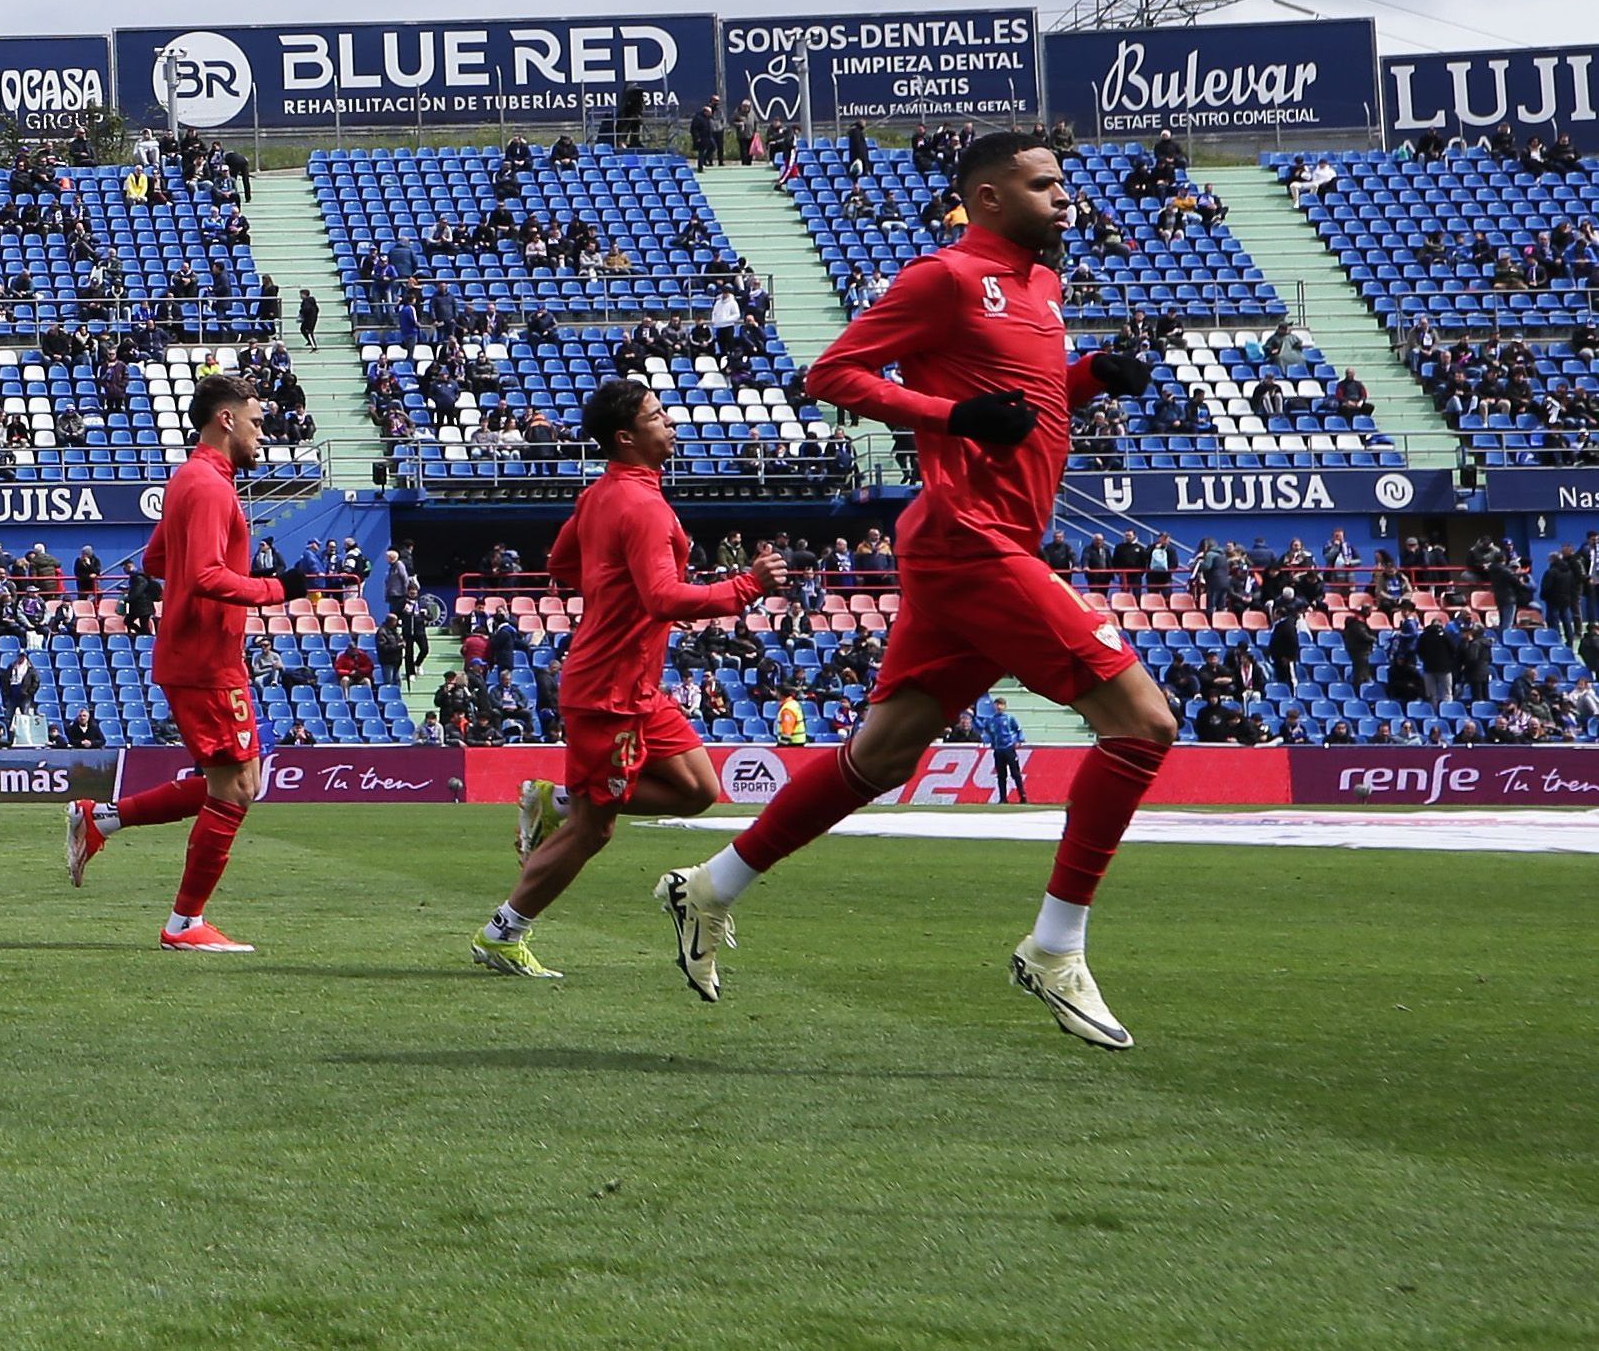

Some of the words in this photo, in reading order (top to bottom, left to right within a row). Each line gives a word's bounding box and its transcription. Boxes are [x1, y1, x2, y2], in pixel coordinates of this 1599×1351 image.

[279, 30, 490, 90] BLUE
[509, 25, 678, 85] RED
[833, 55, 933, 75] LIMPIEZA
[940, 52, 1024, 72] DENTAL
[176, 60, 240, 98] BR
[893, 77, 969, 97] GRATIS
[1102, 40, 1317, 112] Bulevar
[284, 92, 446, 115] REHABILITACIÓN
[453, 96, 477, 111] DE
[483, 91, 577, 110] TUBERÍAS
[586, 92, 616, 107] SIN
[643, 91, 679, 106] BRA
[1390, 55, 1597, 130] LUJI
[956, 101, 973, 112] EN
[1104, 113, 1161, 130] GETAFE
[1170, 111, 1229, 128] CENTRO
[1233, 107, 1319, 125] COMERCIAL
[982, 276, 1002, 298] 15
[1175, 474, 1334, 511] LUJISA
[230, 689, 248, 722] 5
[0, 761, 69, 792] más
[318, 764, 353, 790] Tu
[359, 767, 433, 790] tren
[733, 761, 773, 780] EA
[1339, 753, 1479, 804] renfe
[1495, 765, 1534, 793] Tu
[733, 782, 776, 792] SPORTS
